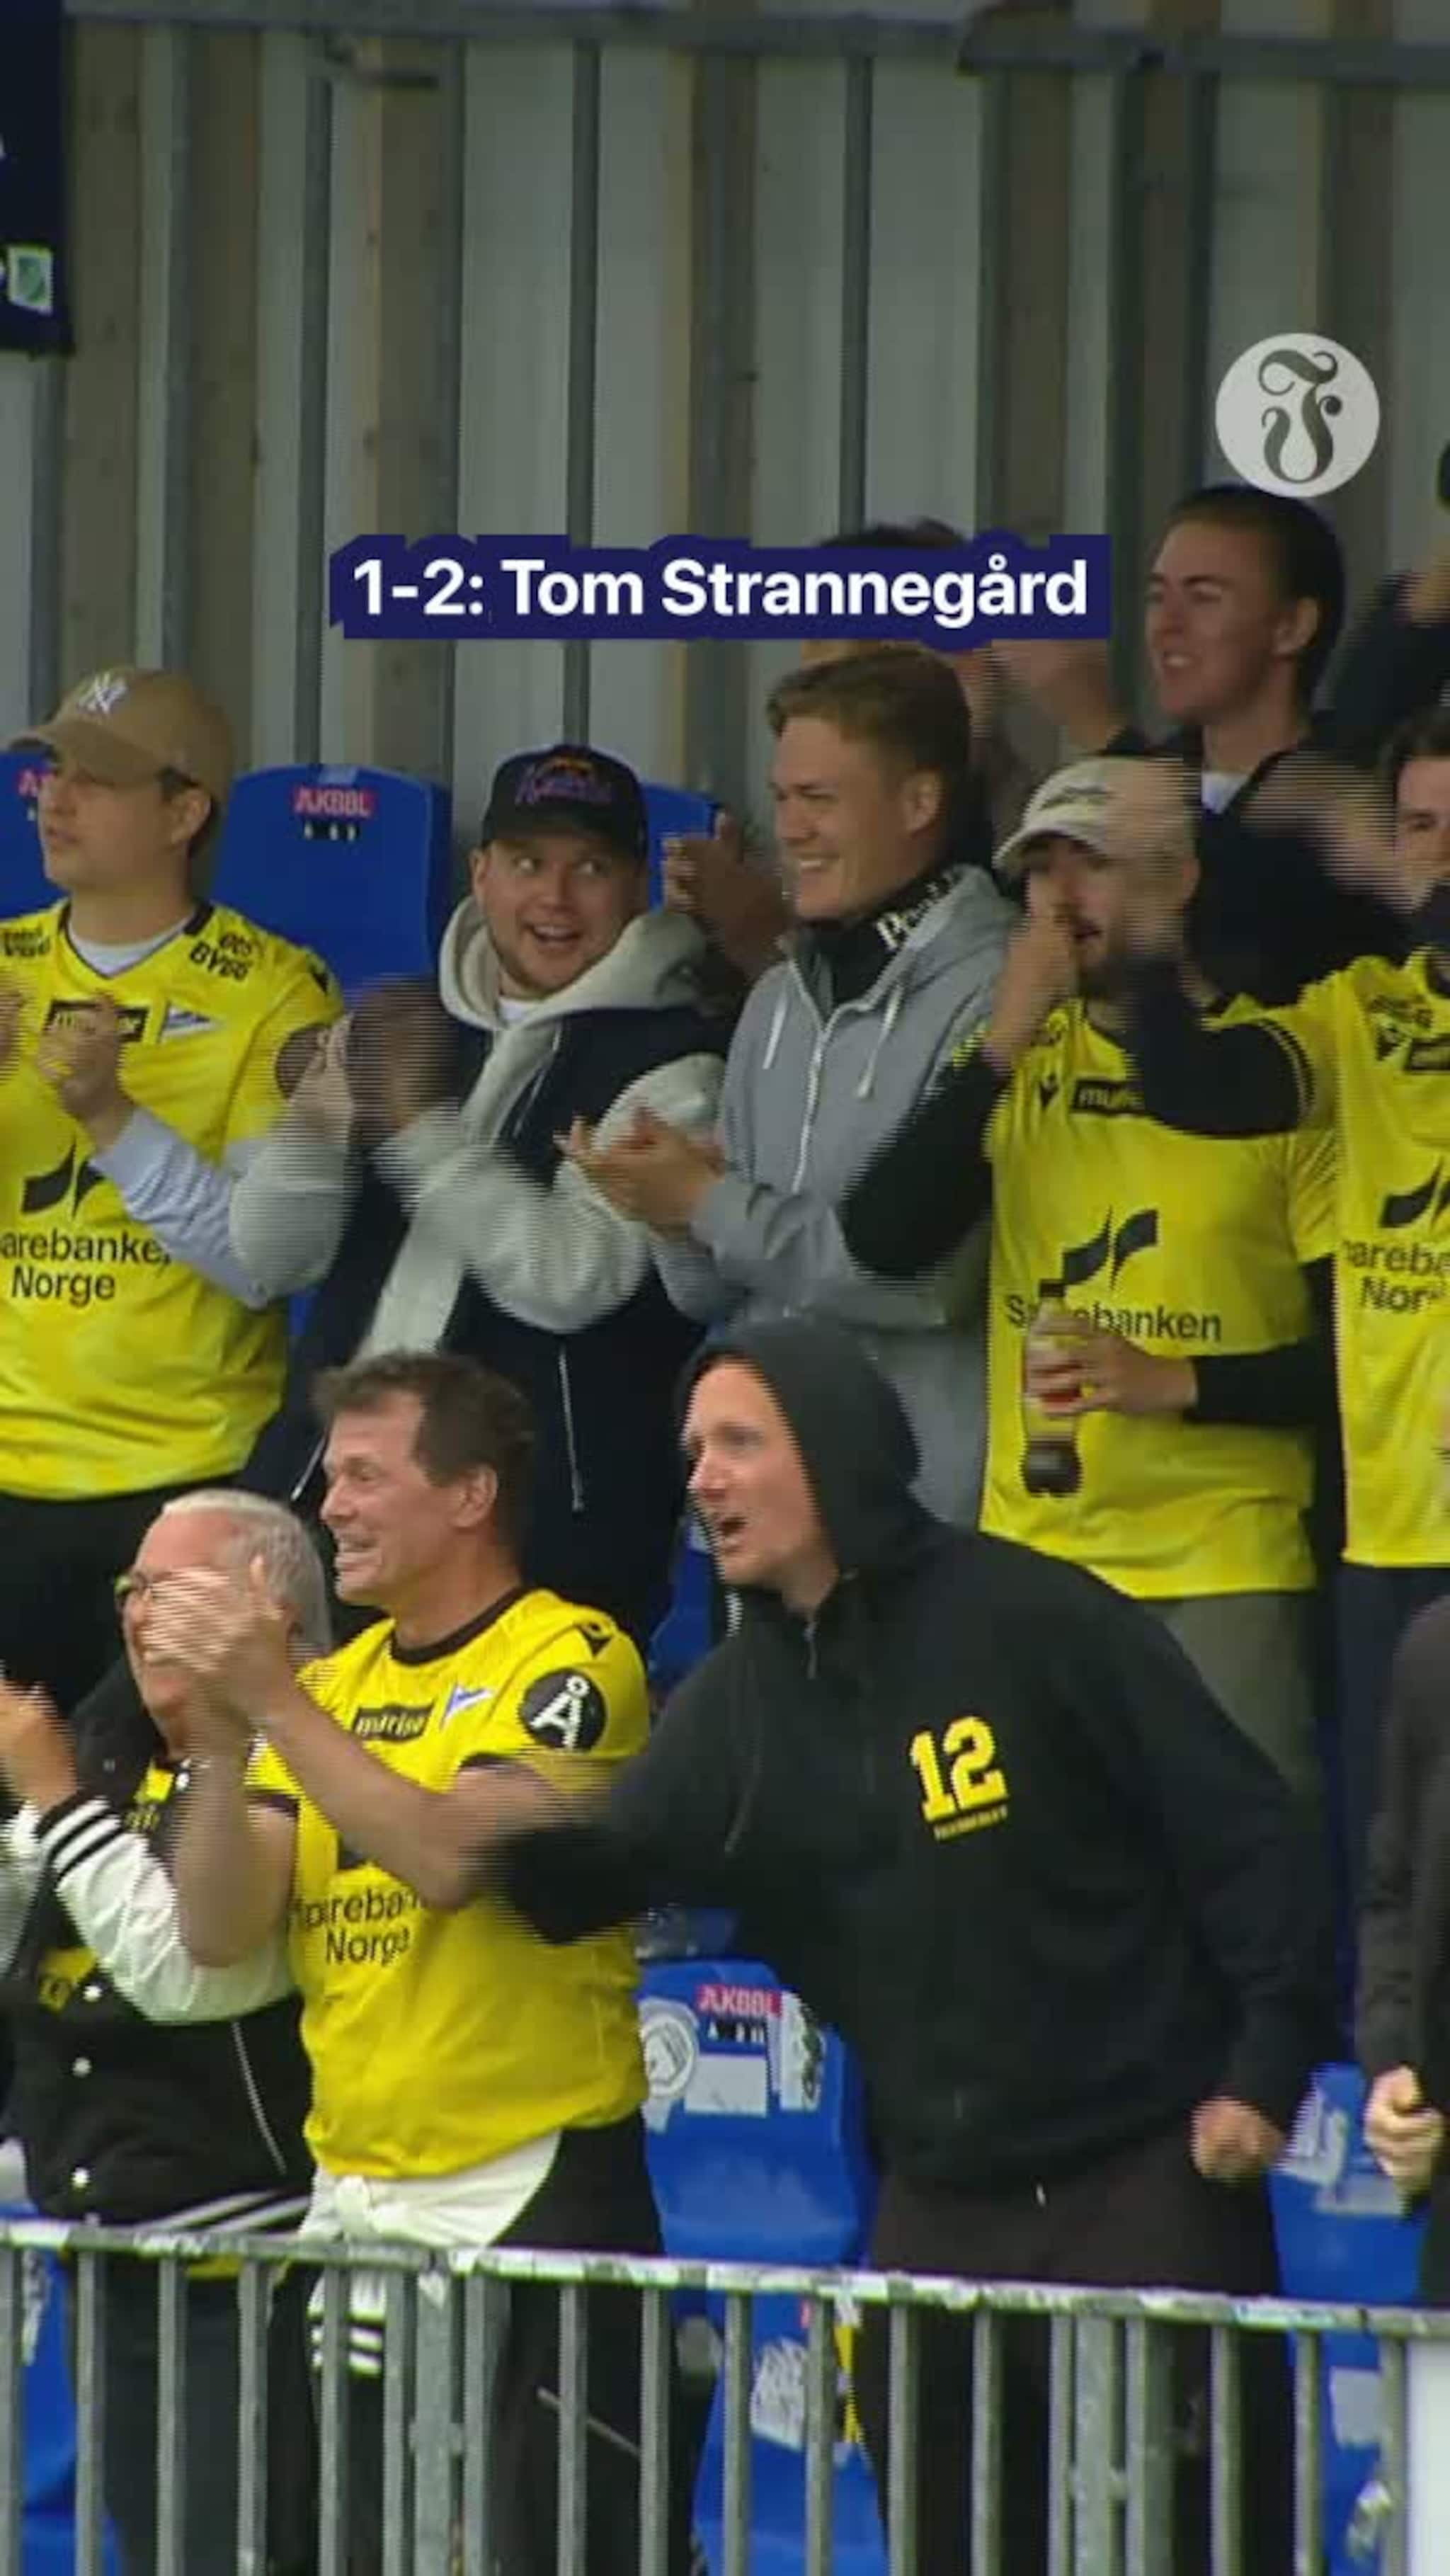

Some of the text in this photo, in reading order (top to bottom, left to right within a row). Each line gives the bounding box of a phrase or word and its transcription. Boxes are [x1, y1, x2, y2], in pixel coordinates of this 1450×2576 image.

[0, 1228, 172, 1266] arebanke
[11, 1265, 115, 1307] Norge
[530, 1674, 590, 1750] Å
[909, 1715, 1009, 1823] 12
